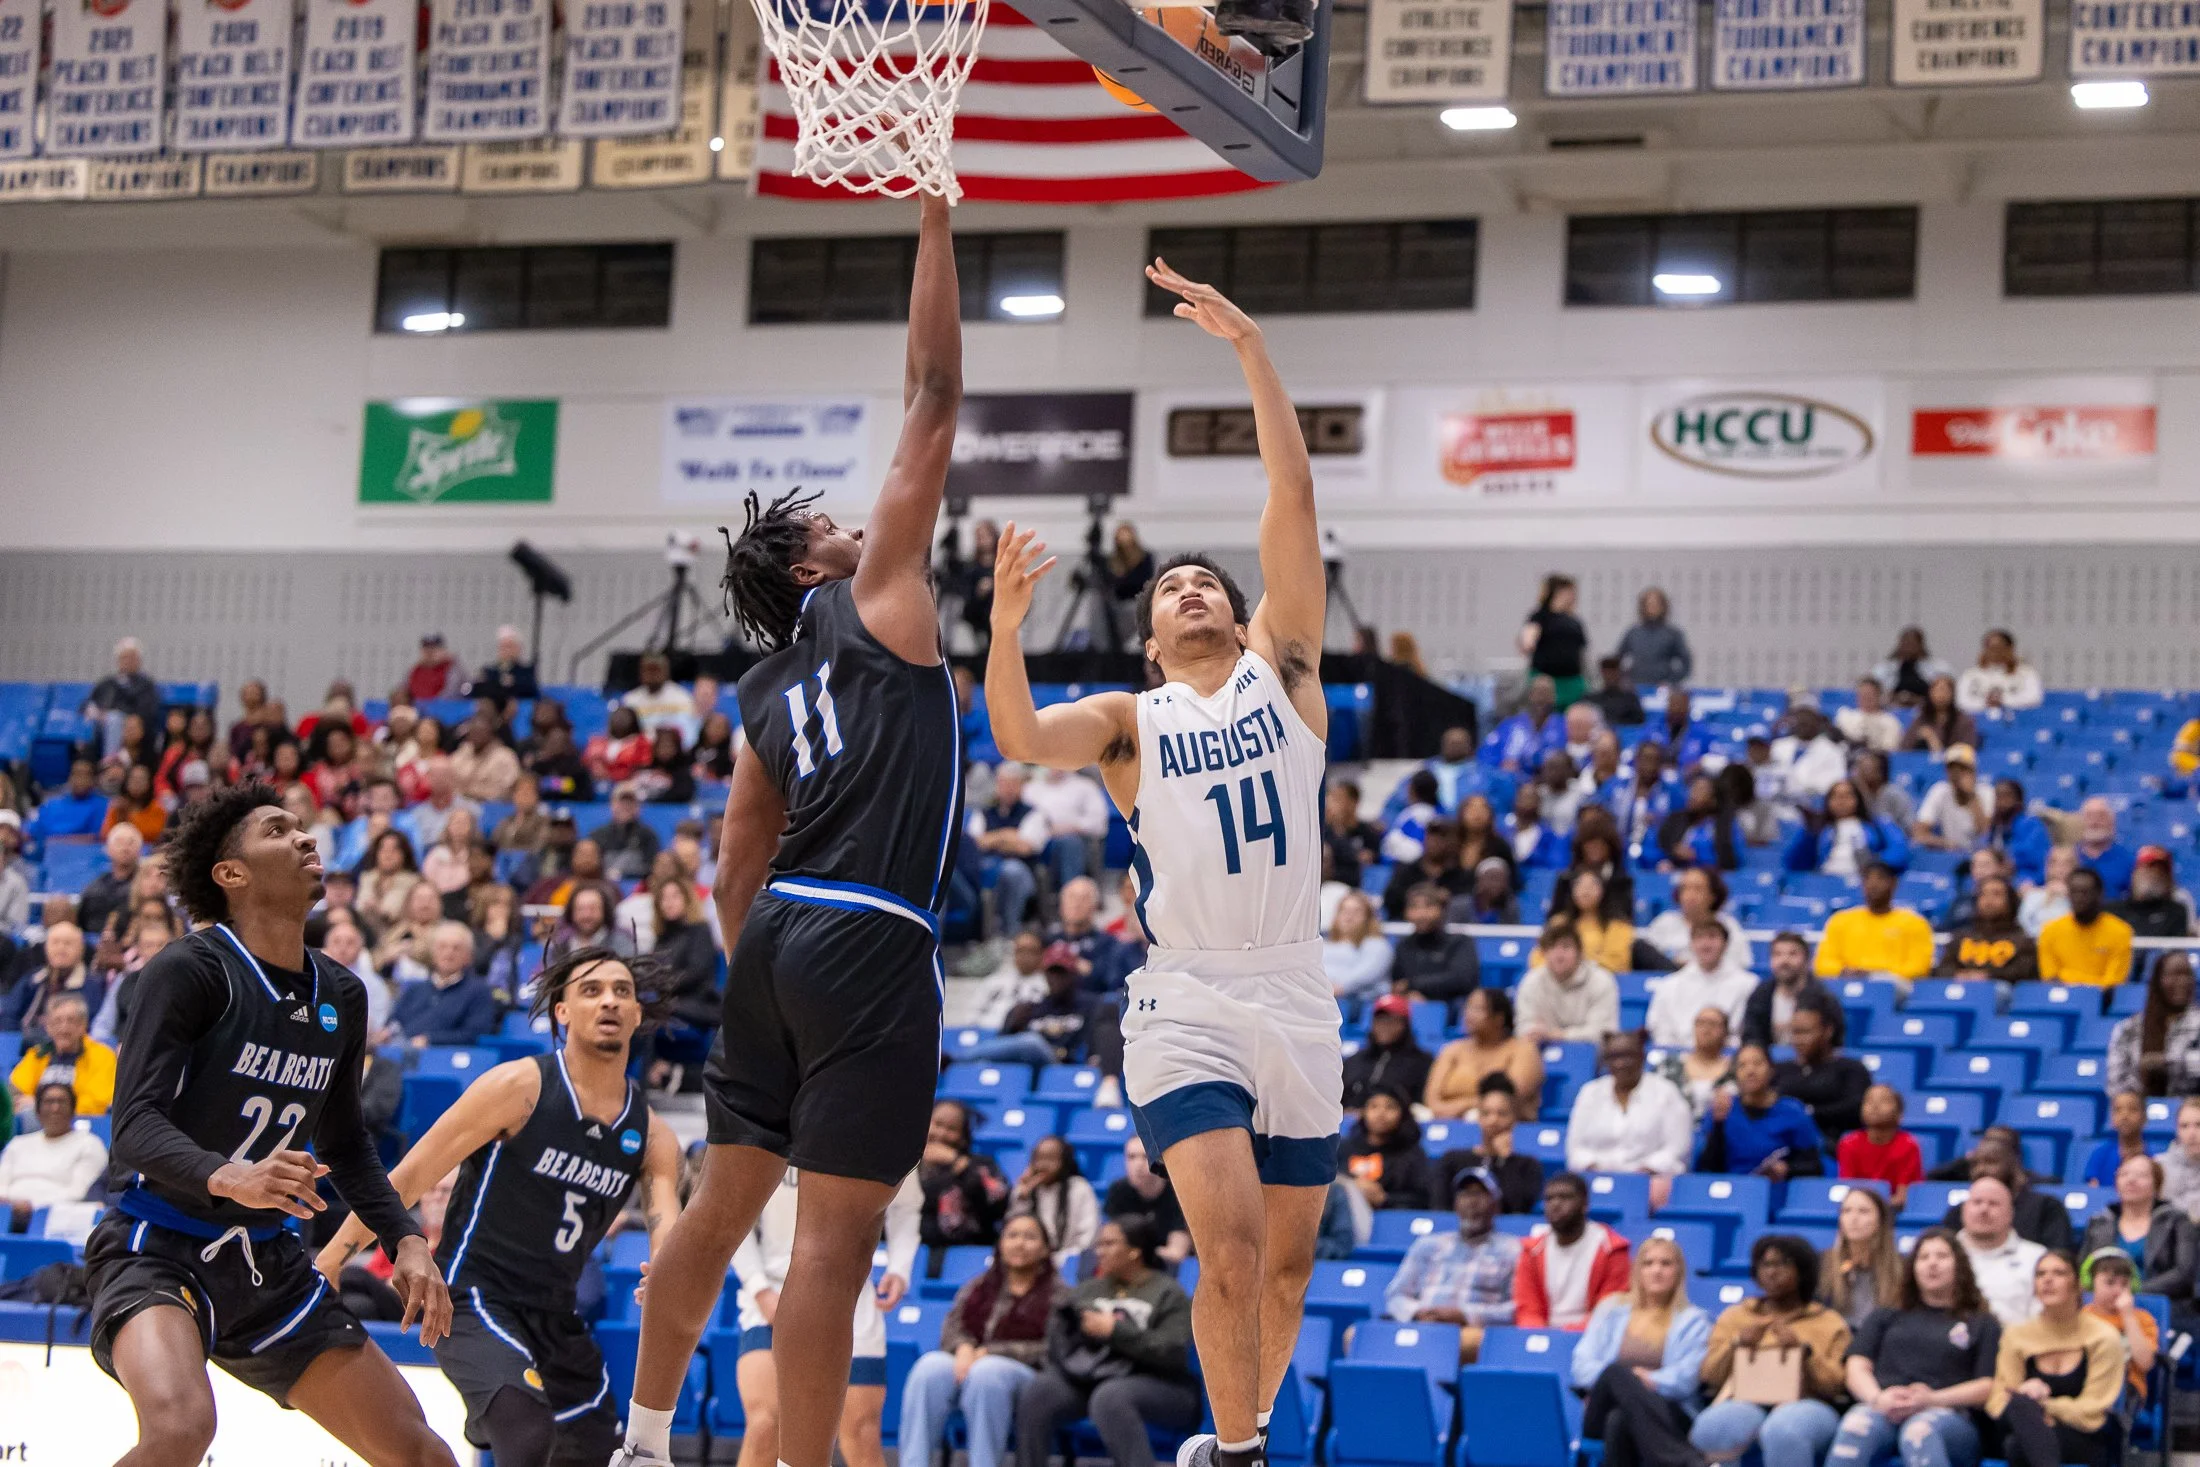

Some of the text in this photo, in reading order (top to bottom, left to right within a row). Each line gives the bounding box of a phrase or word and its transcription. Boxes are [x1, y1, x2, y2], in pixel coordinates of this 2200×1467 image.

[1911, 16, 2027, 43] CONFERENCE
[311, 48, 358, 74] EACH
[1916, 46, 2020, 73] CHAMPIONS
[953, 428, 1124, 463] OWERADE
[1674, 404, 1815, 445] HCCU
[784, 657, 843, 781] 11
[1158, 700, 1289, 778] AUGUSTA
[1204, 769, 1287, 875] 14
[229, 1096, 306, 1166] 22
[533, 1146, 629, 1198] BEARCATS
[554, 1190, 587, 1253] 5
